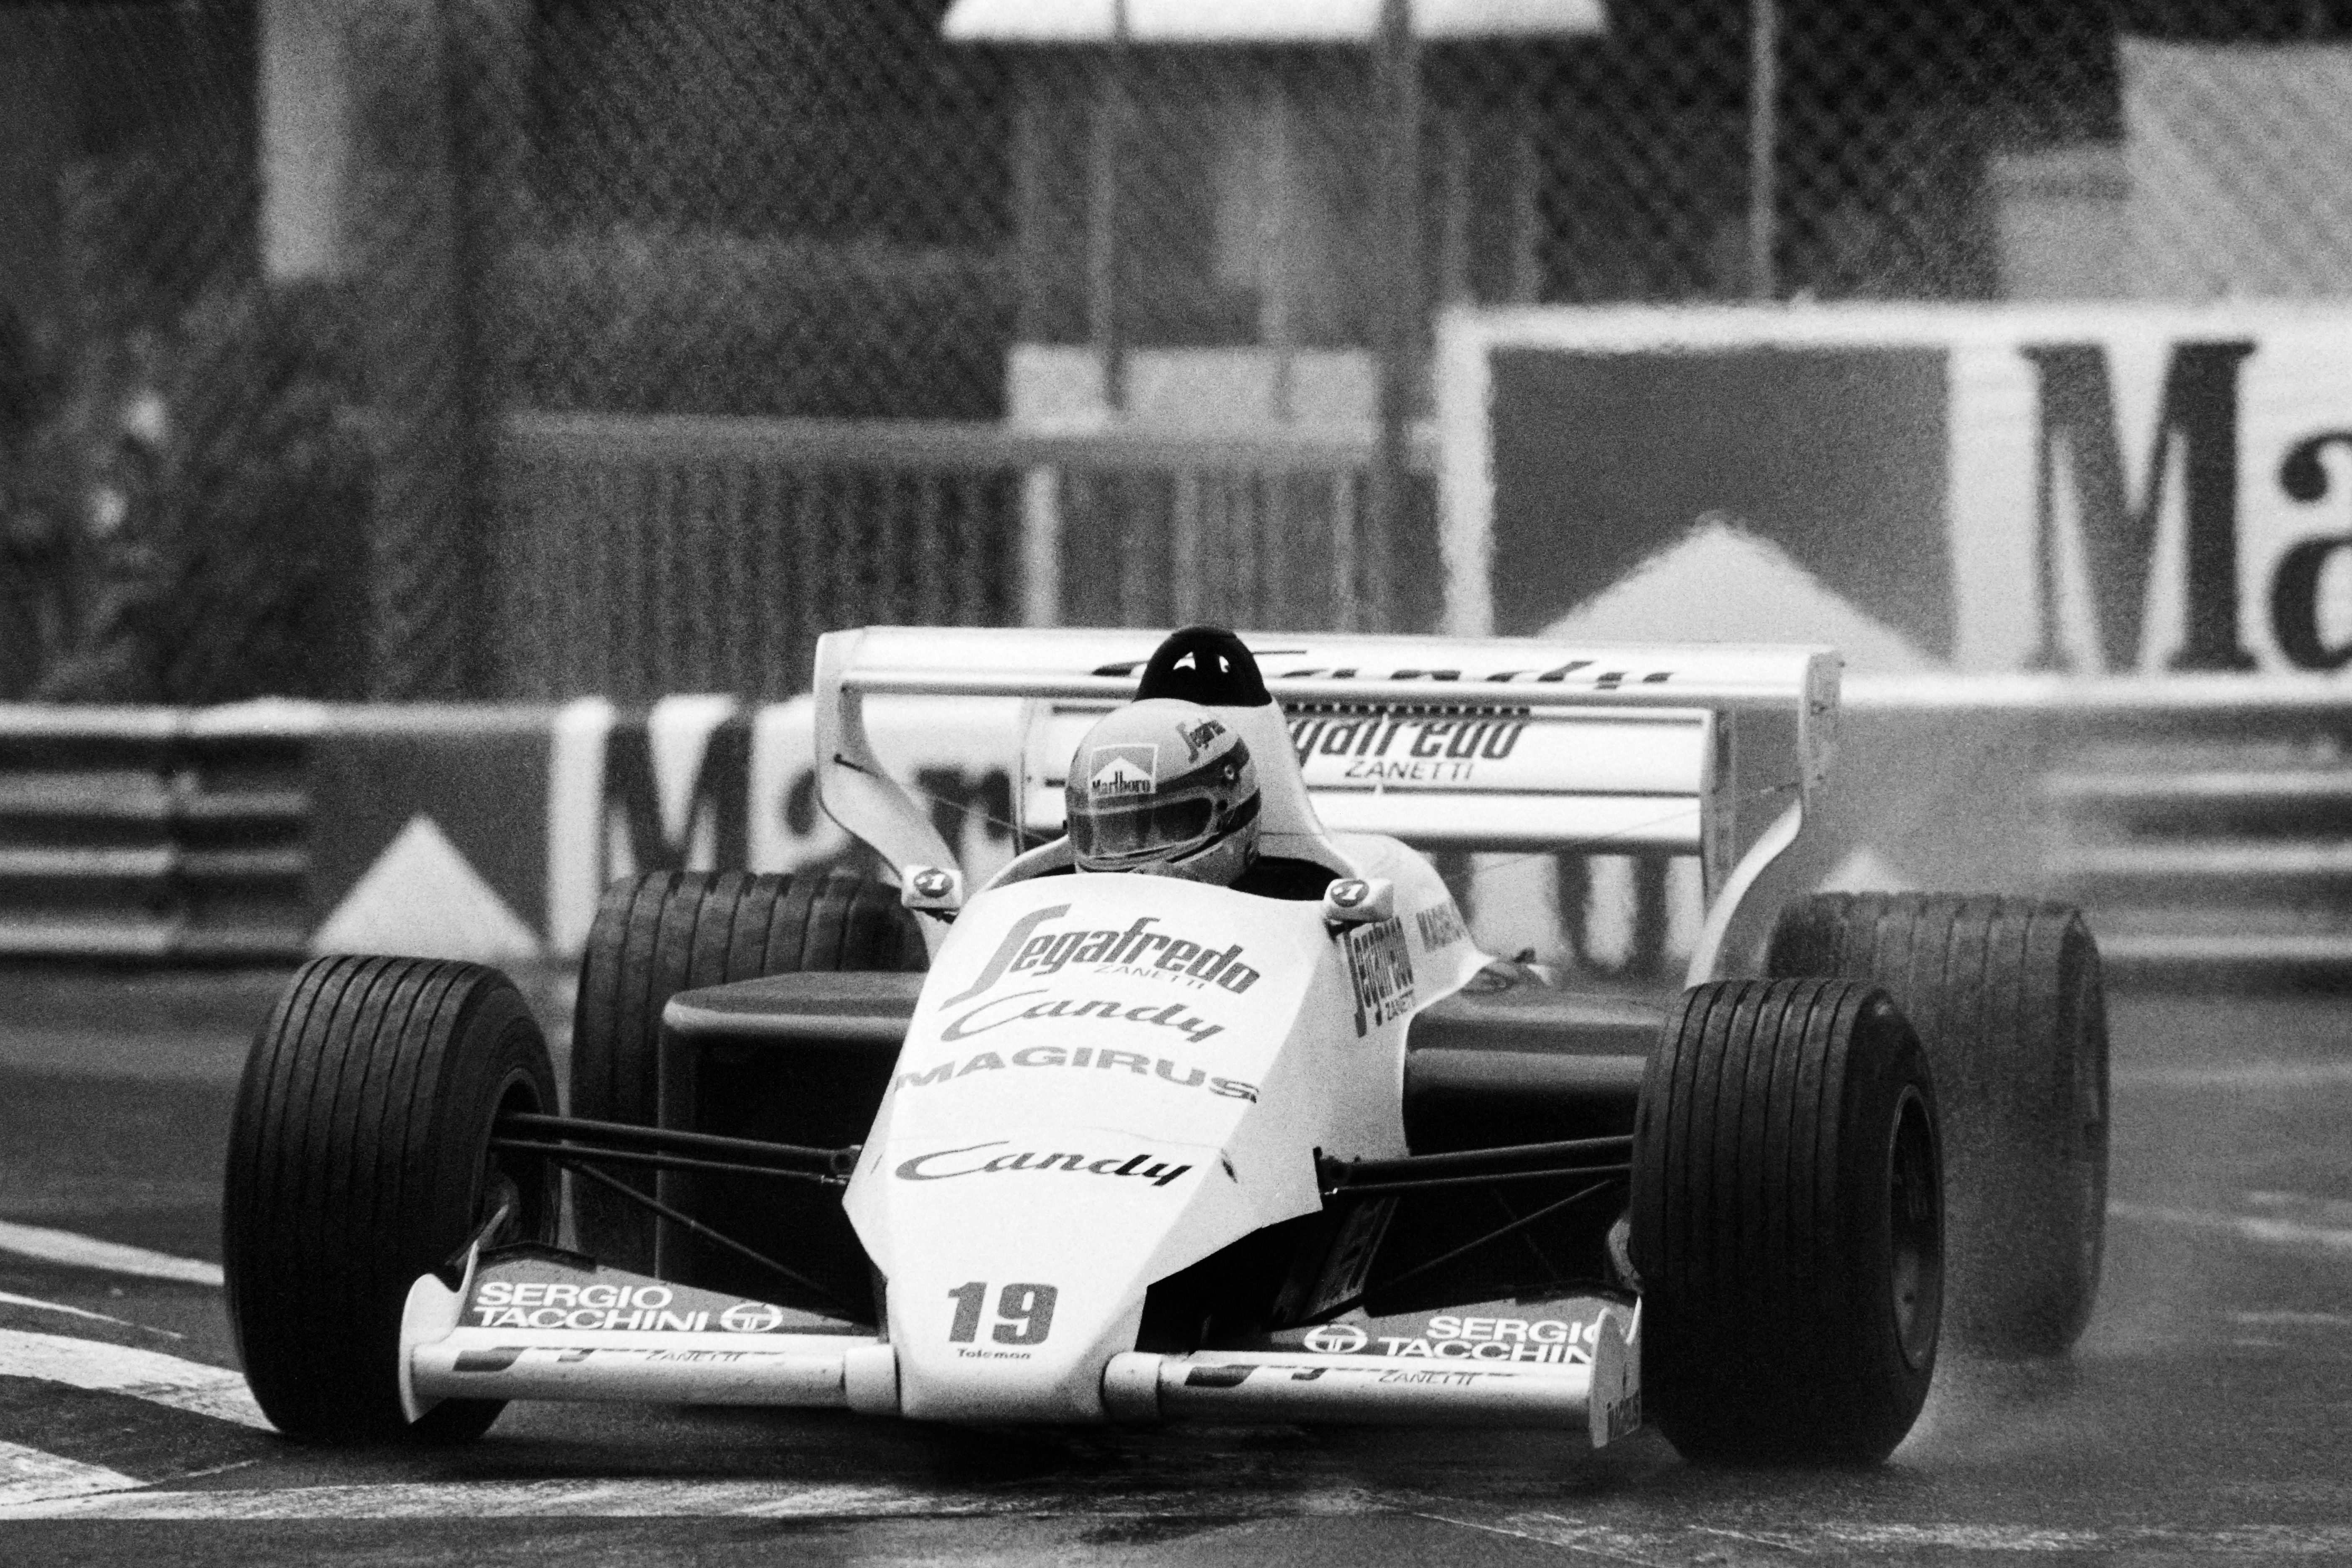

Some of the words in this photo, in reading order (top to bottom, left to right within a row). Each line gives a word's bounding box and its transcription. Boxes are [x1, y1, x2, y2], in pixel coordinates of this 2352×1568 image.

[1091, 770, 1151, 793] Marlboro
[1344, 759, 1473, 781] ZANETTI
[938, 903, 1261, 1011] Segafredo
[1094, 964, 1207, 989] ZANETTI
[940, 988, 1225, 1043] Candy
[895, 1046, 1259, 1104] MAGIRUS
[895, 1140, 1192, 1186] Candy
[477, 1282, 672, 1308] SERGIO
[473, 1307, 708, 1331] TACCHINI
[948, 1282, 1058, 1345] 19
[957, 1347, 1032, 1360] Toleman
